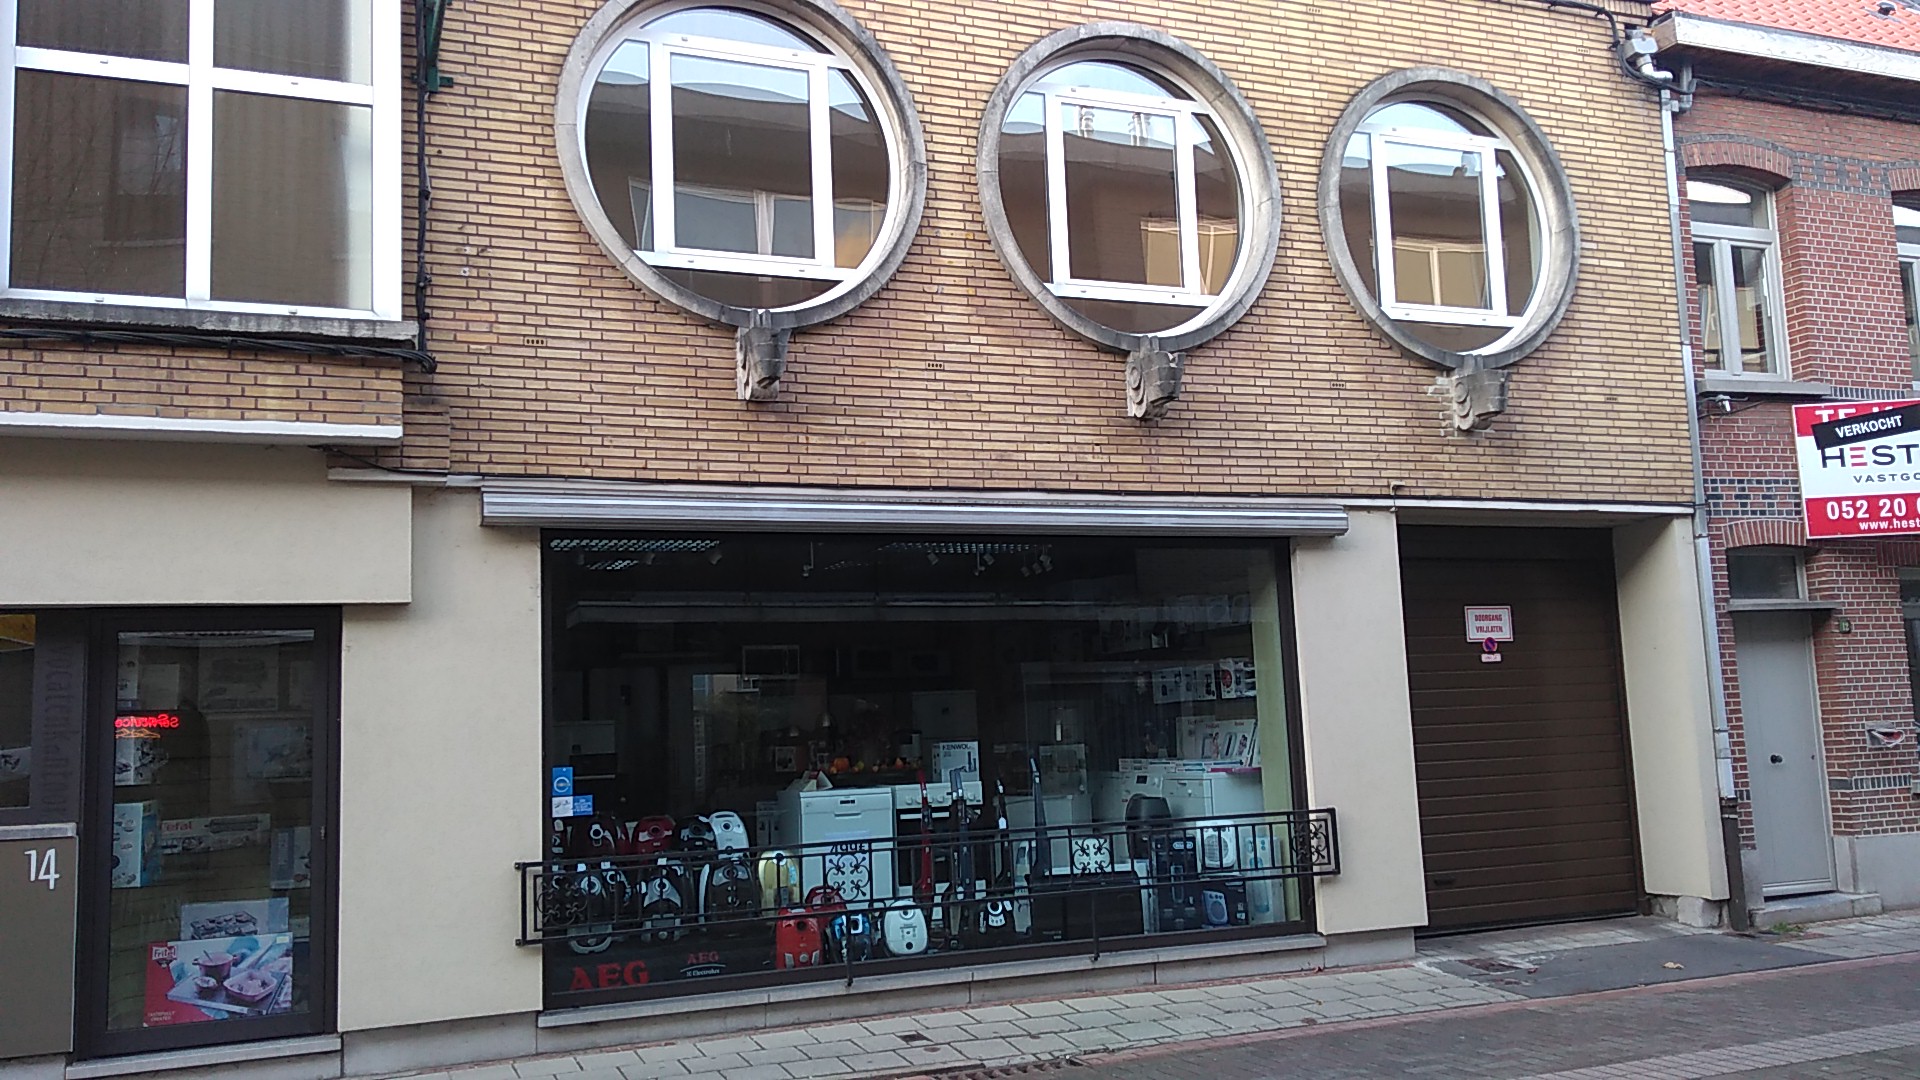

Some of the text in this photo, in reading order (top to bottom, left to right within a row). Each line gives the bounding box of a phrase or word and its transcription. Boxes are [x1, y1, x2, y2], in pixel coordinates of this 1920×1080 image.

[1835, 415, 1902, 438] VERKOCHT
[1826, 499, 1870, 520] 052
[1878, 498, 1907, 518] 20
[1474, 614, 1503, 622] DOORGANG
[24, 847, 61, 890] 14
[687, 950, 720, 965] AEG
[570, 959, 649, 991] AEG
